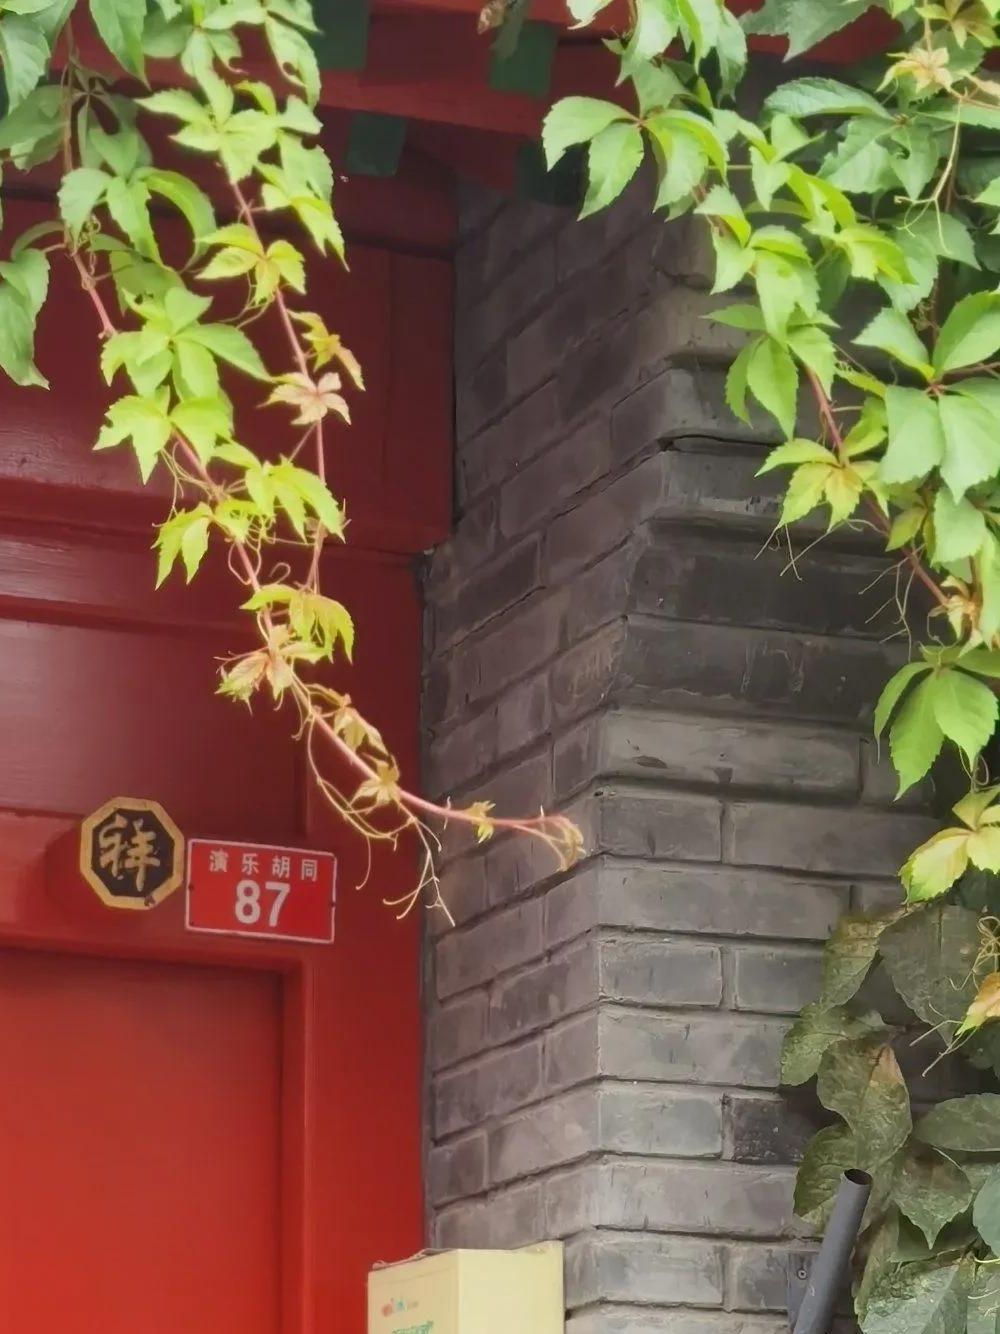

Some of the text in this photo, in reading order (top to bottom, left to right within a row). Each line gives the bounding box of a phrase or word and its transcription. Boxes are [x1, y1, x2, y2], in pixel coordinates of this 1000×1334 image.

[99, 813, 160, 893] 祥
[209, 849, 319, 882] 演乐胡同
[234, 879, 291, 928] 87
